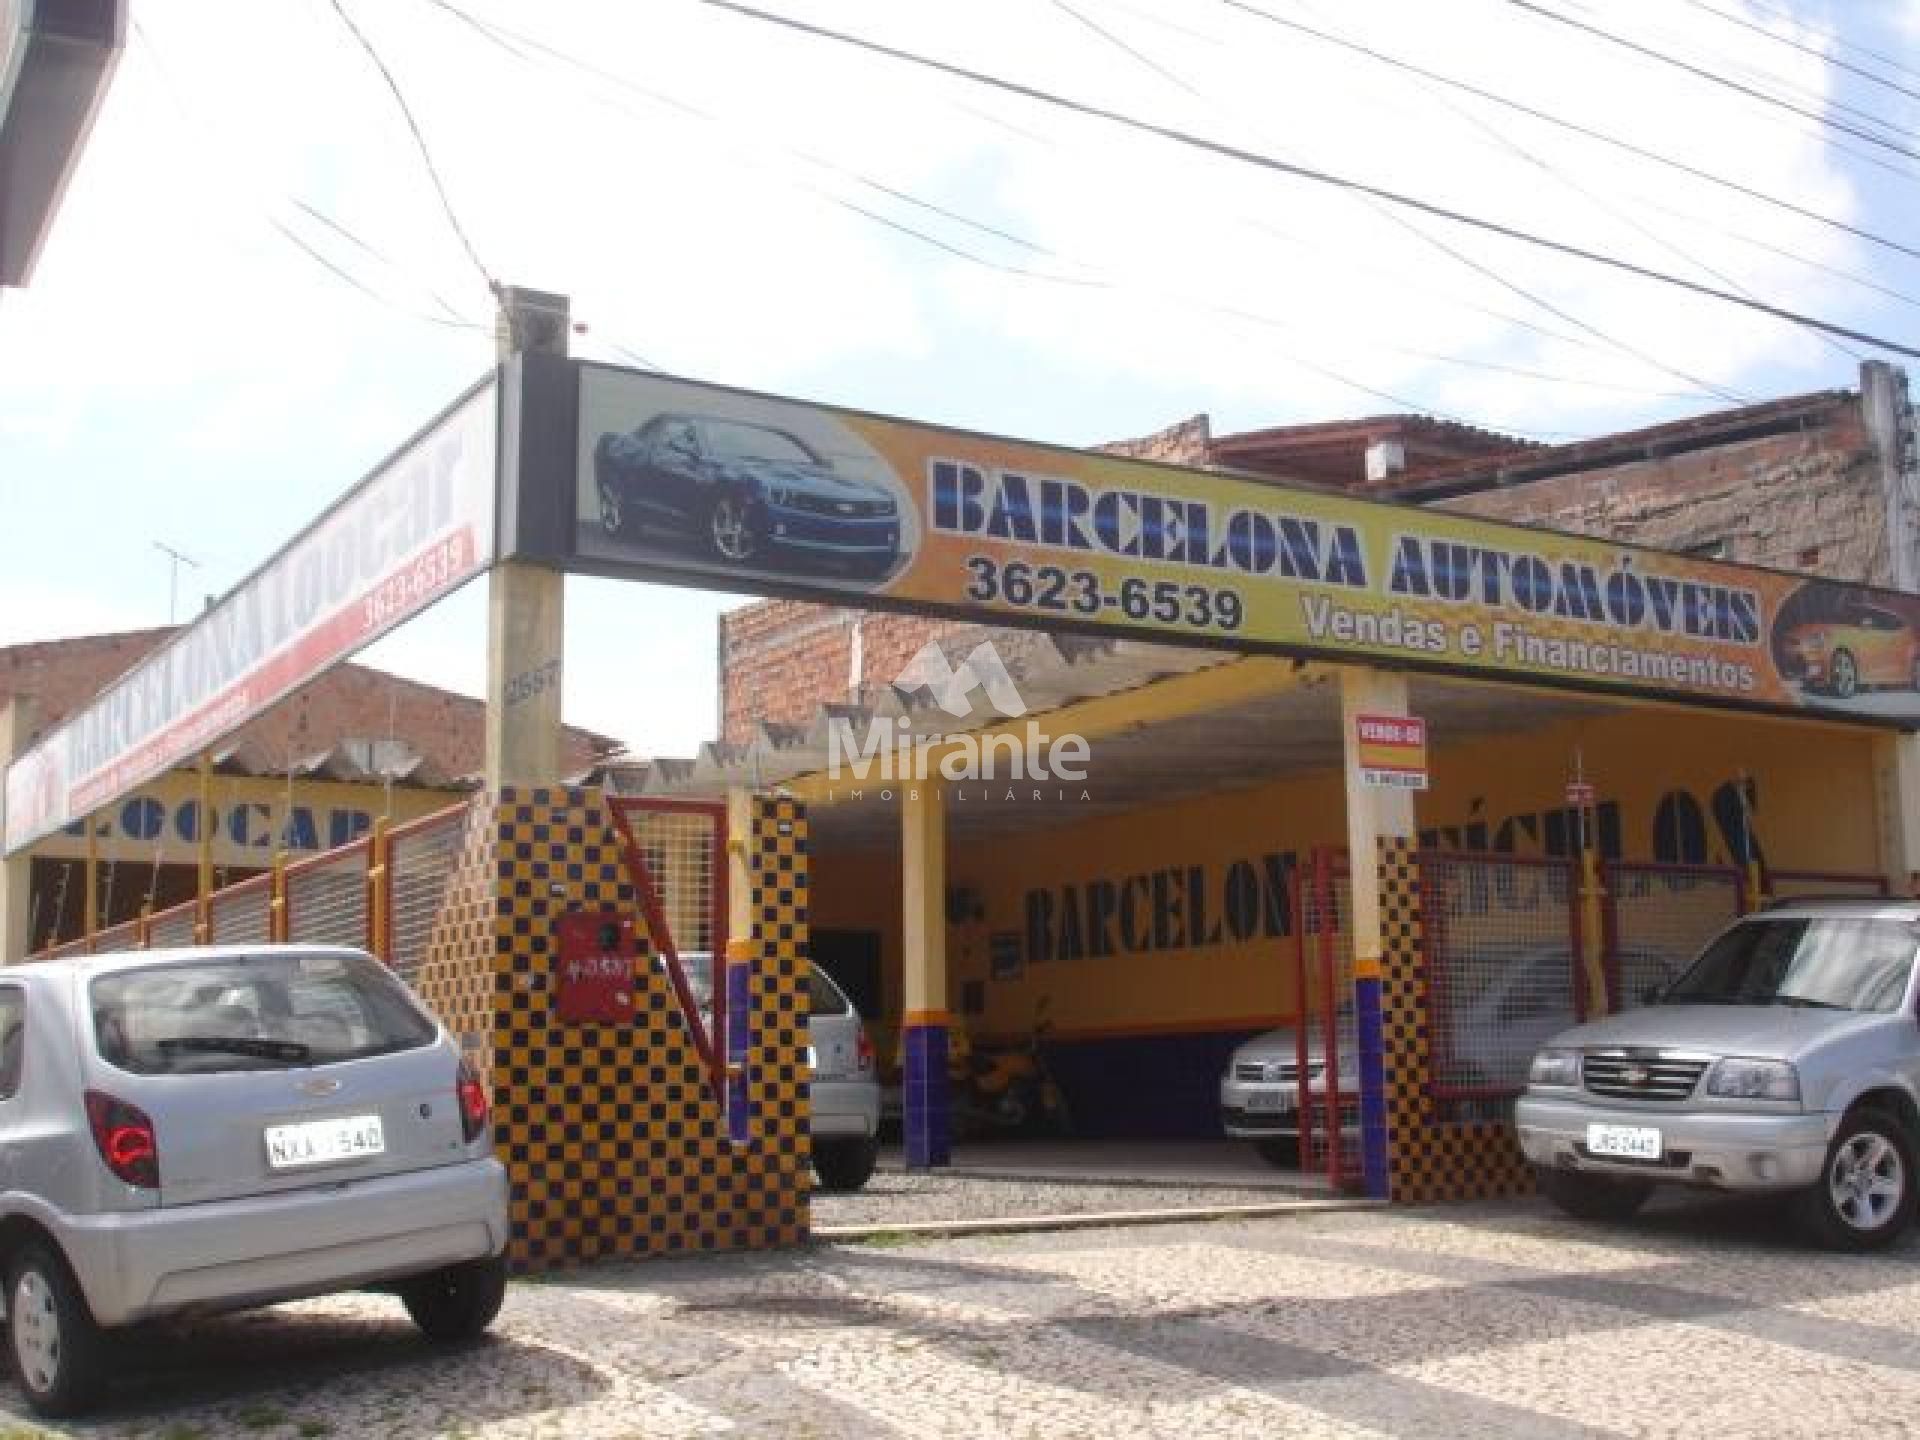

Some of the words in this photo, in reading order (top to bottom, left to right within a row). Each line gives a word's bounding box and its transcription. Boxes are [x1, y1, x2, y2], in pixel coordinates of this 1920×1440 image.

[930, 460, 1368, 587] BARCELONA
[1390, 536, 1760, 642] AUTOMÓVEIS
[966, 556, 1243, 631] 3623-6539
[1301, 597, 1447, 652] Vendas
[1460, 623, 1489, 655] e
[1496, 624, 1755, 693] Financiamentos
